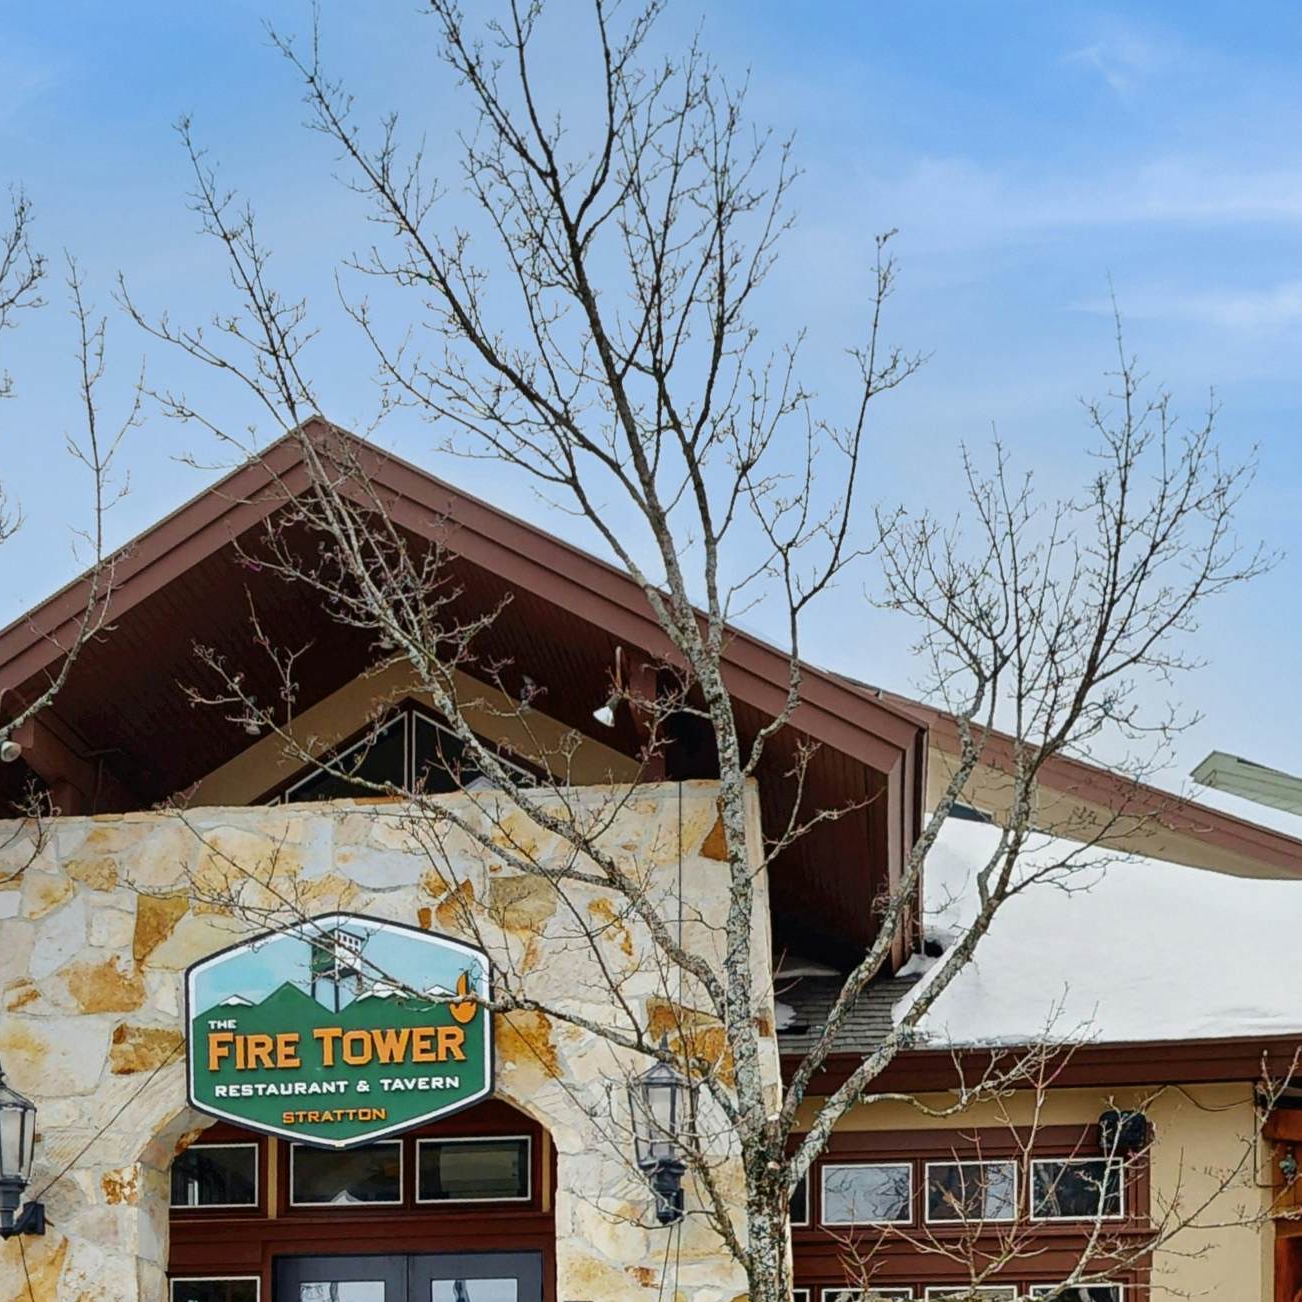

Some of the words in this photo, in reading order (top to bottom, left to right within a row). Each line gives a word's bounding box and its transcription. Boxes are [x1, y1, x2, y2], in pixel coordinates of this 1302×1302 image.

[208, 1020, 237, 1029] THE
[207, 1032, 301, 1070] FIRE
[313, 1026, 467, 1066] TOWER
[215, 1081, 348, 1097] RESTAURANT
[356, 1080, 370, 1092] &
[380, 1077, 459, 1091] TAVERN
[282, 1108, 387, 1124] STRATTON
